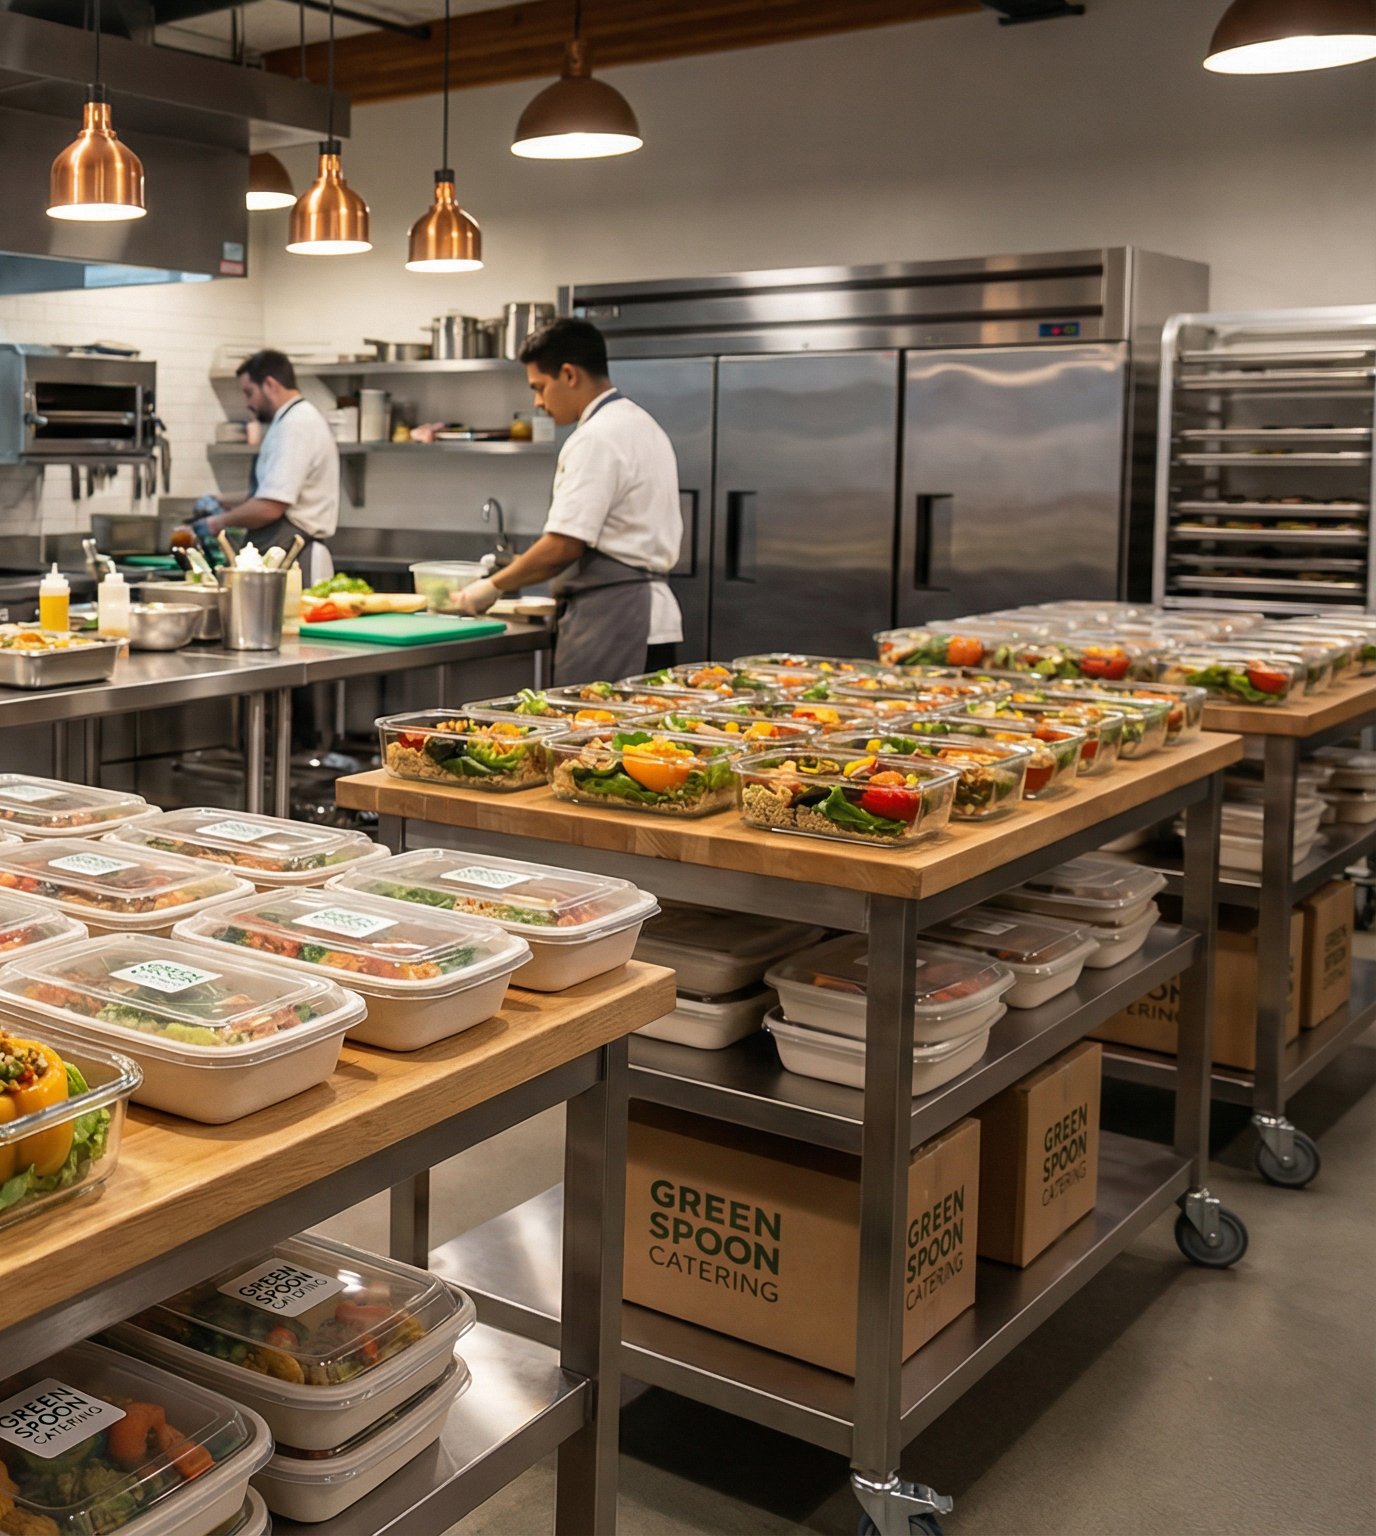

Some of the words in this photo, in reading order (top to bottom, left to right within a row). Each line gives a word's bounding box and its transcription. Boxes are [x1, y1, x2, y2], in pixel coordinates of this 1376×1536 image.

[1044, 1102, 1088, 1153] GREEN
[1042, 1131, 1087, 1183] SPOON
[650, 1179, 781, 1242] GREEN
[907, 1184, 965, 1249] GREEN
[648, 1211, 779, 1276] SPOON
[906, 1217, 963, 1284] SPOON
[238, 1265, 299, 1297] GREEN
[255, 1272, 314, 1305] SPOON
[649, 1245, 778, 1303] CATERING
[14, 1396, 89, 1439] SPOON
